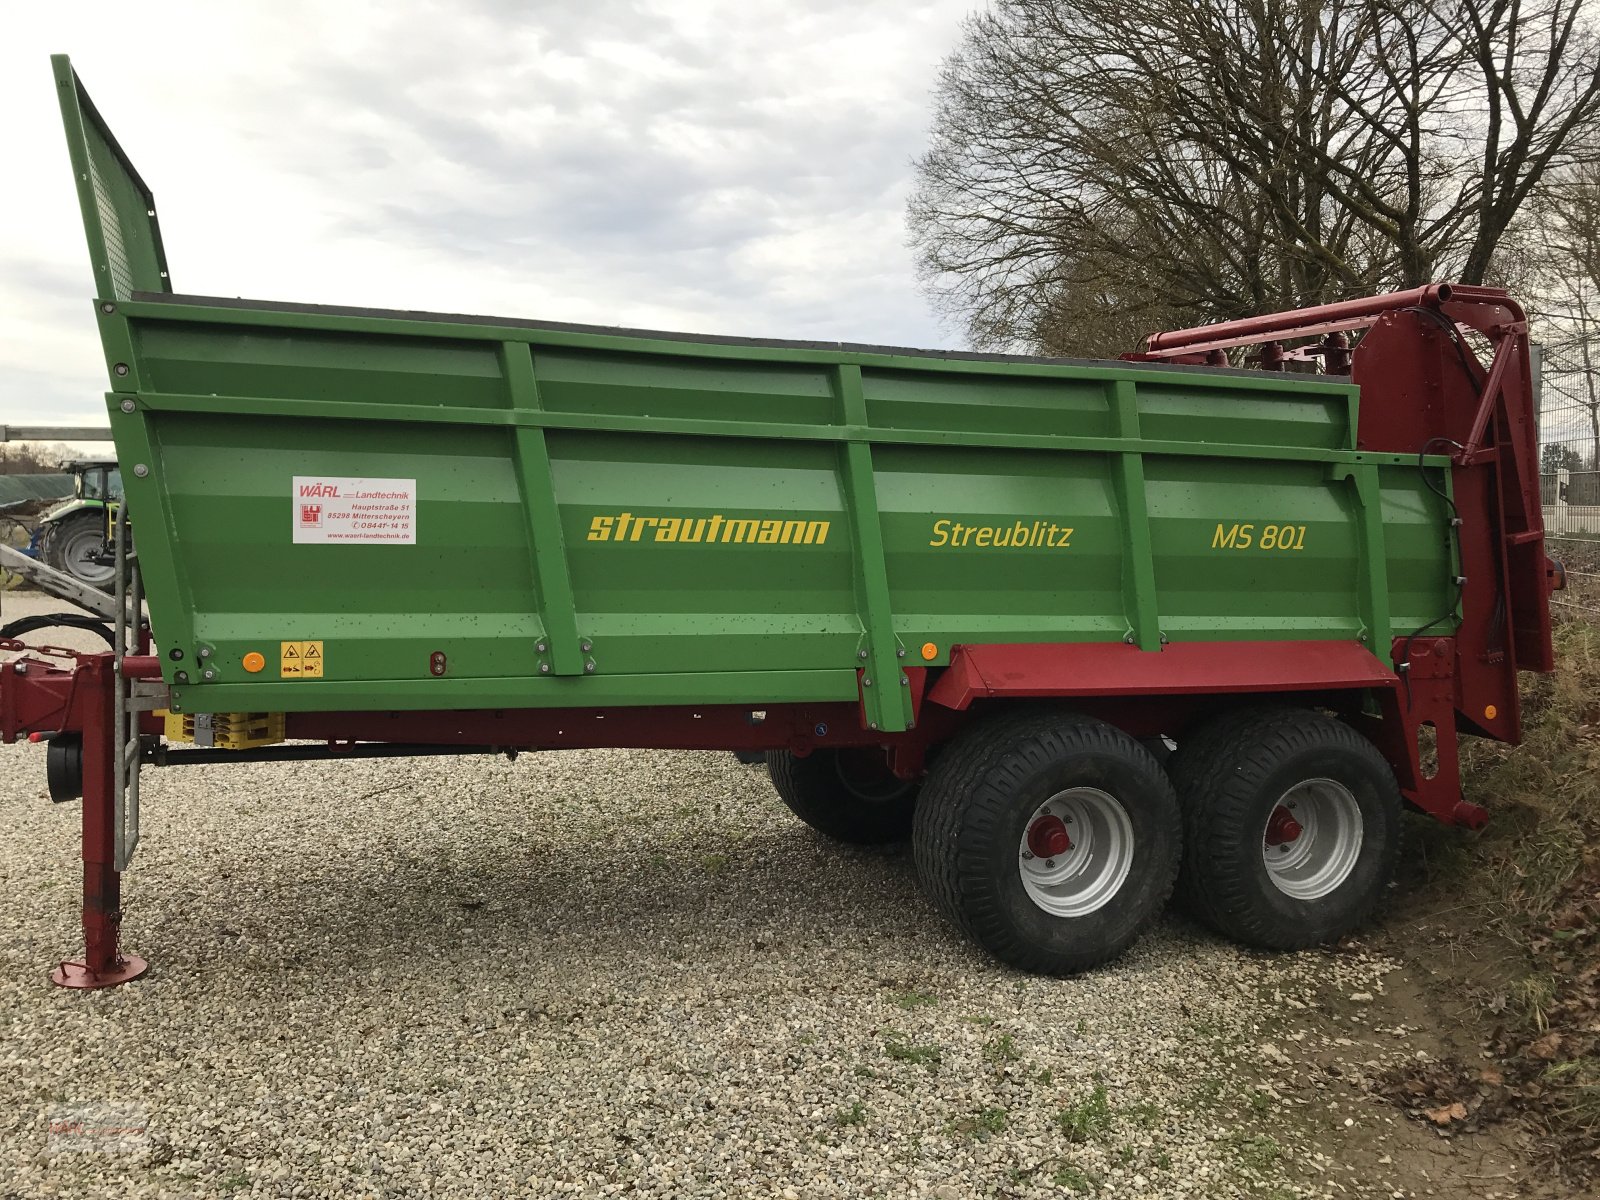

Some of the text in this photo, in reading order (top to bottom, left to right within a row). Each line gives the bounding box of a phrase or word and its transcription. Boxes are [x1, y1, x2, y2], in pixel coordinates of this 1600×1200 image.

[300, 483, 409, 500] WÄRL Landtechnik
[351, 503, 399, 511] Hauptstraße
[587, 512, 831, 544] strautmann
[929, 519, 1074, 547] Streublitz
[1211, 524, 1305, 551] MS 801
